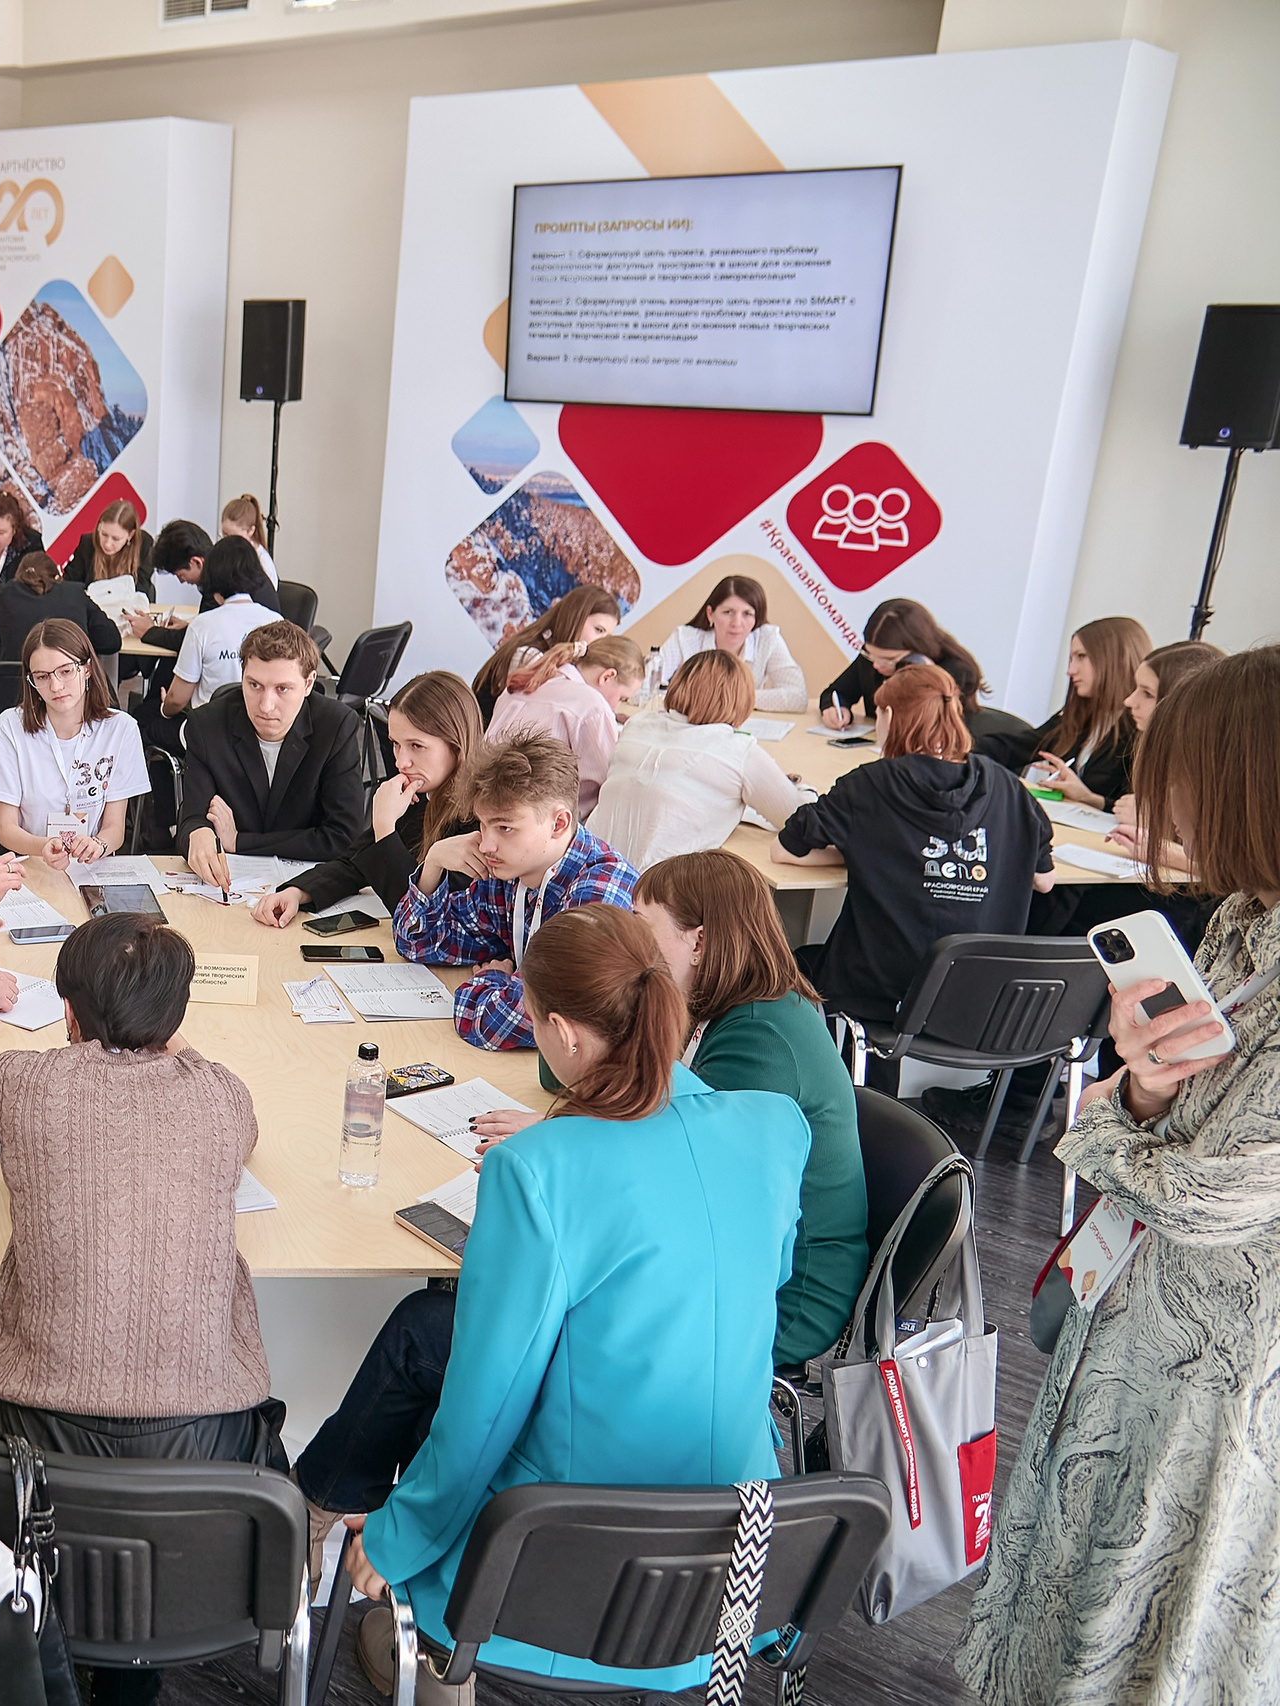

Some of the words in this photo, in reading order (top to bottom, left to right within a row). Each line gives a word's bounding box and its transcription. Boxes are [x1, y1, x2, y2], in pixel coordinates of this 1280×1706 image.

[534, 221, 596, 235] ПРОМПТЫ
[597, 219, 665, 235] (ЗАПРОСЫ
[810, 295, 847, 306] SMART
[884, 1369, 900, 1399] ЛЮДИ
[894, 1399, 910, 1438] РЕШАЮТ
